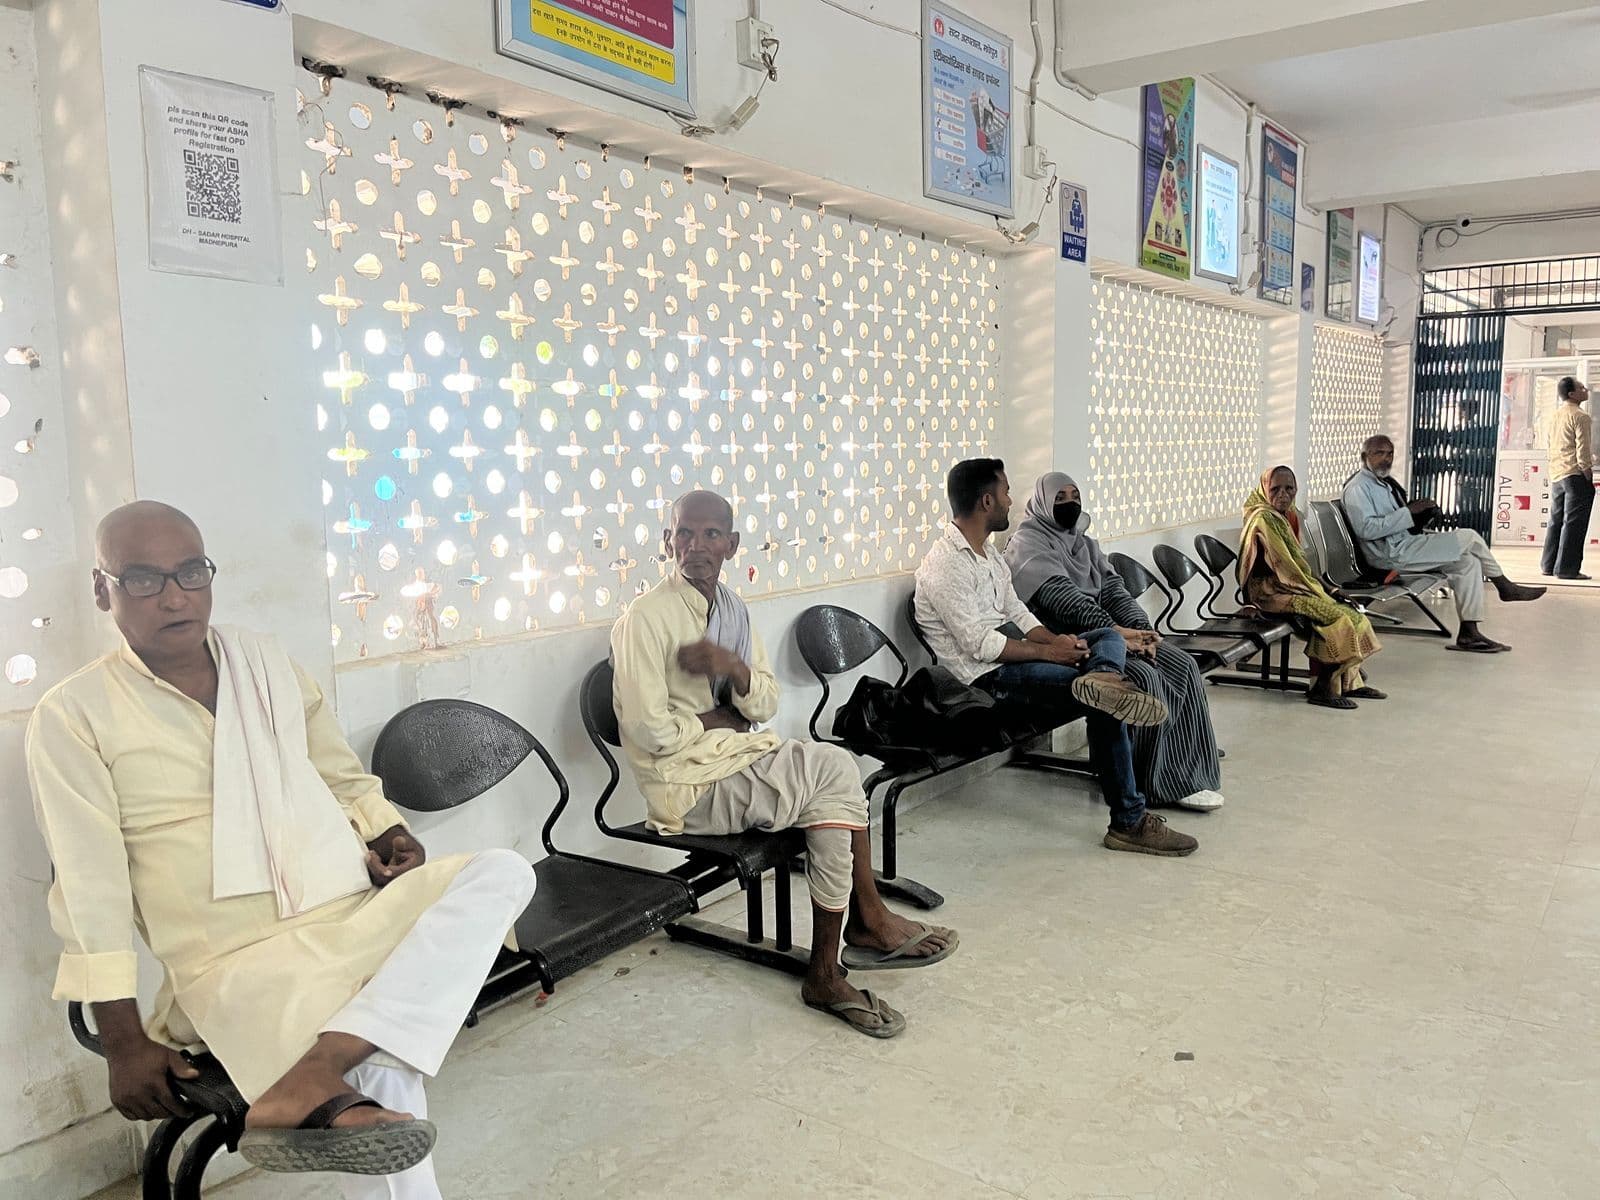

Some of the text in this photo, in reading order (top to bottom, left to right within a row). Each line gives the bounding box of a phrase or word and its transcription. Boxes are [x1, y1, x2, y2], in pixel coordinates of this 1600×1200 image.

[167, 105, 249, 127] pls scan this QR code
[168, 116, 184, 124] and
[185, 119, 207, 129] share
[208, 124, 226, 132] your
[173, 127, 245, 146] profile for fast OPD
[188, 138, 235, 154] Registration
[198, 230, 221, 239] SADAR
[220, 233, 251, 242] HOSPITAL
[198, 238, 238, 248] MADHEPURA
[1064, 234, 1086, 248] WAITING
[1067, 247, 1082, 259] AREA
[1497, 475, 1512, 529] ALLCOR
